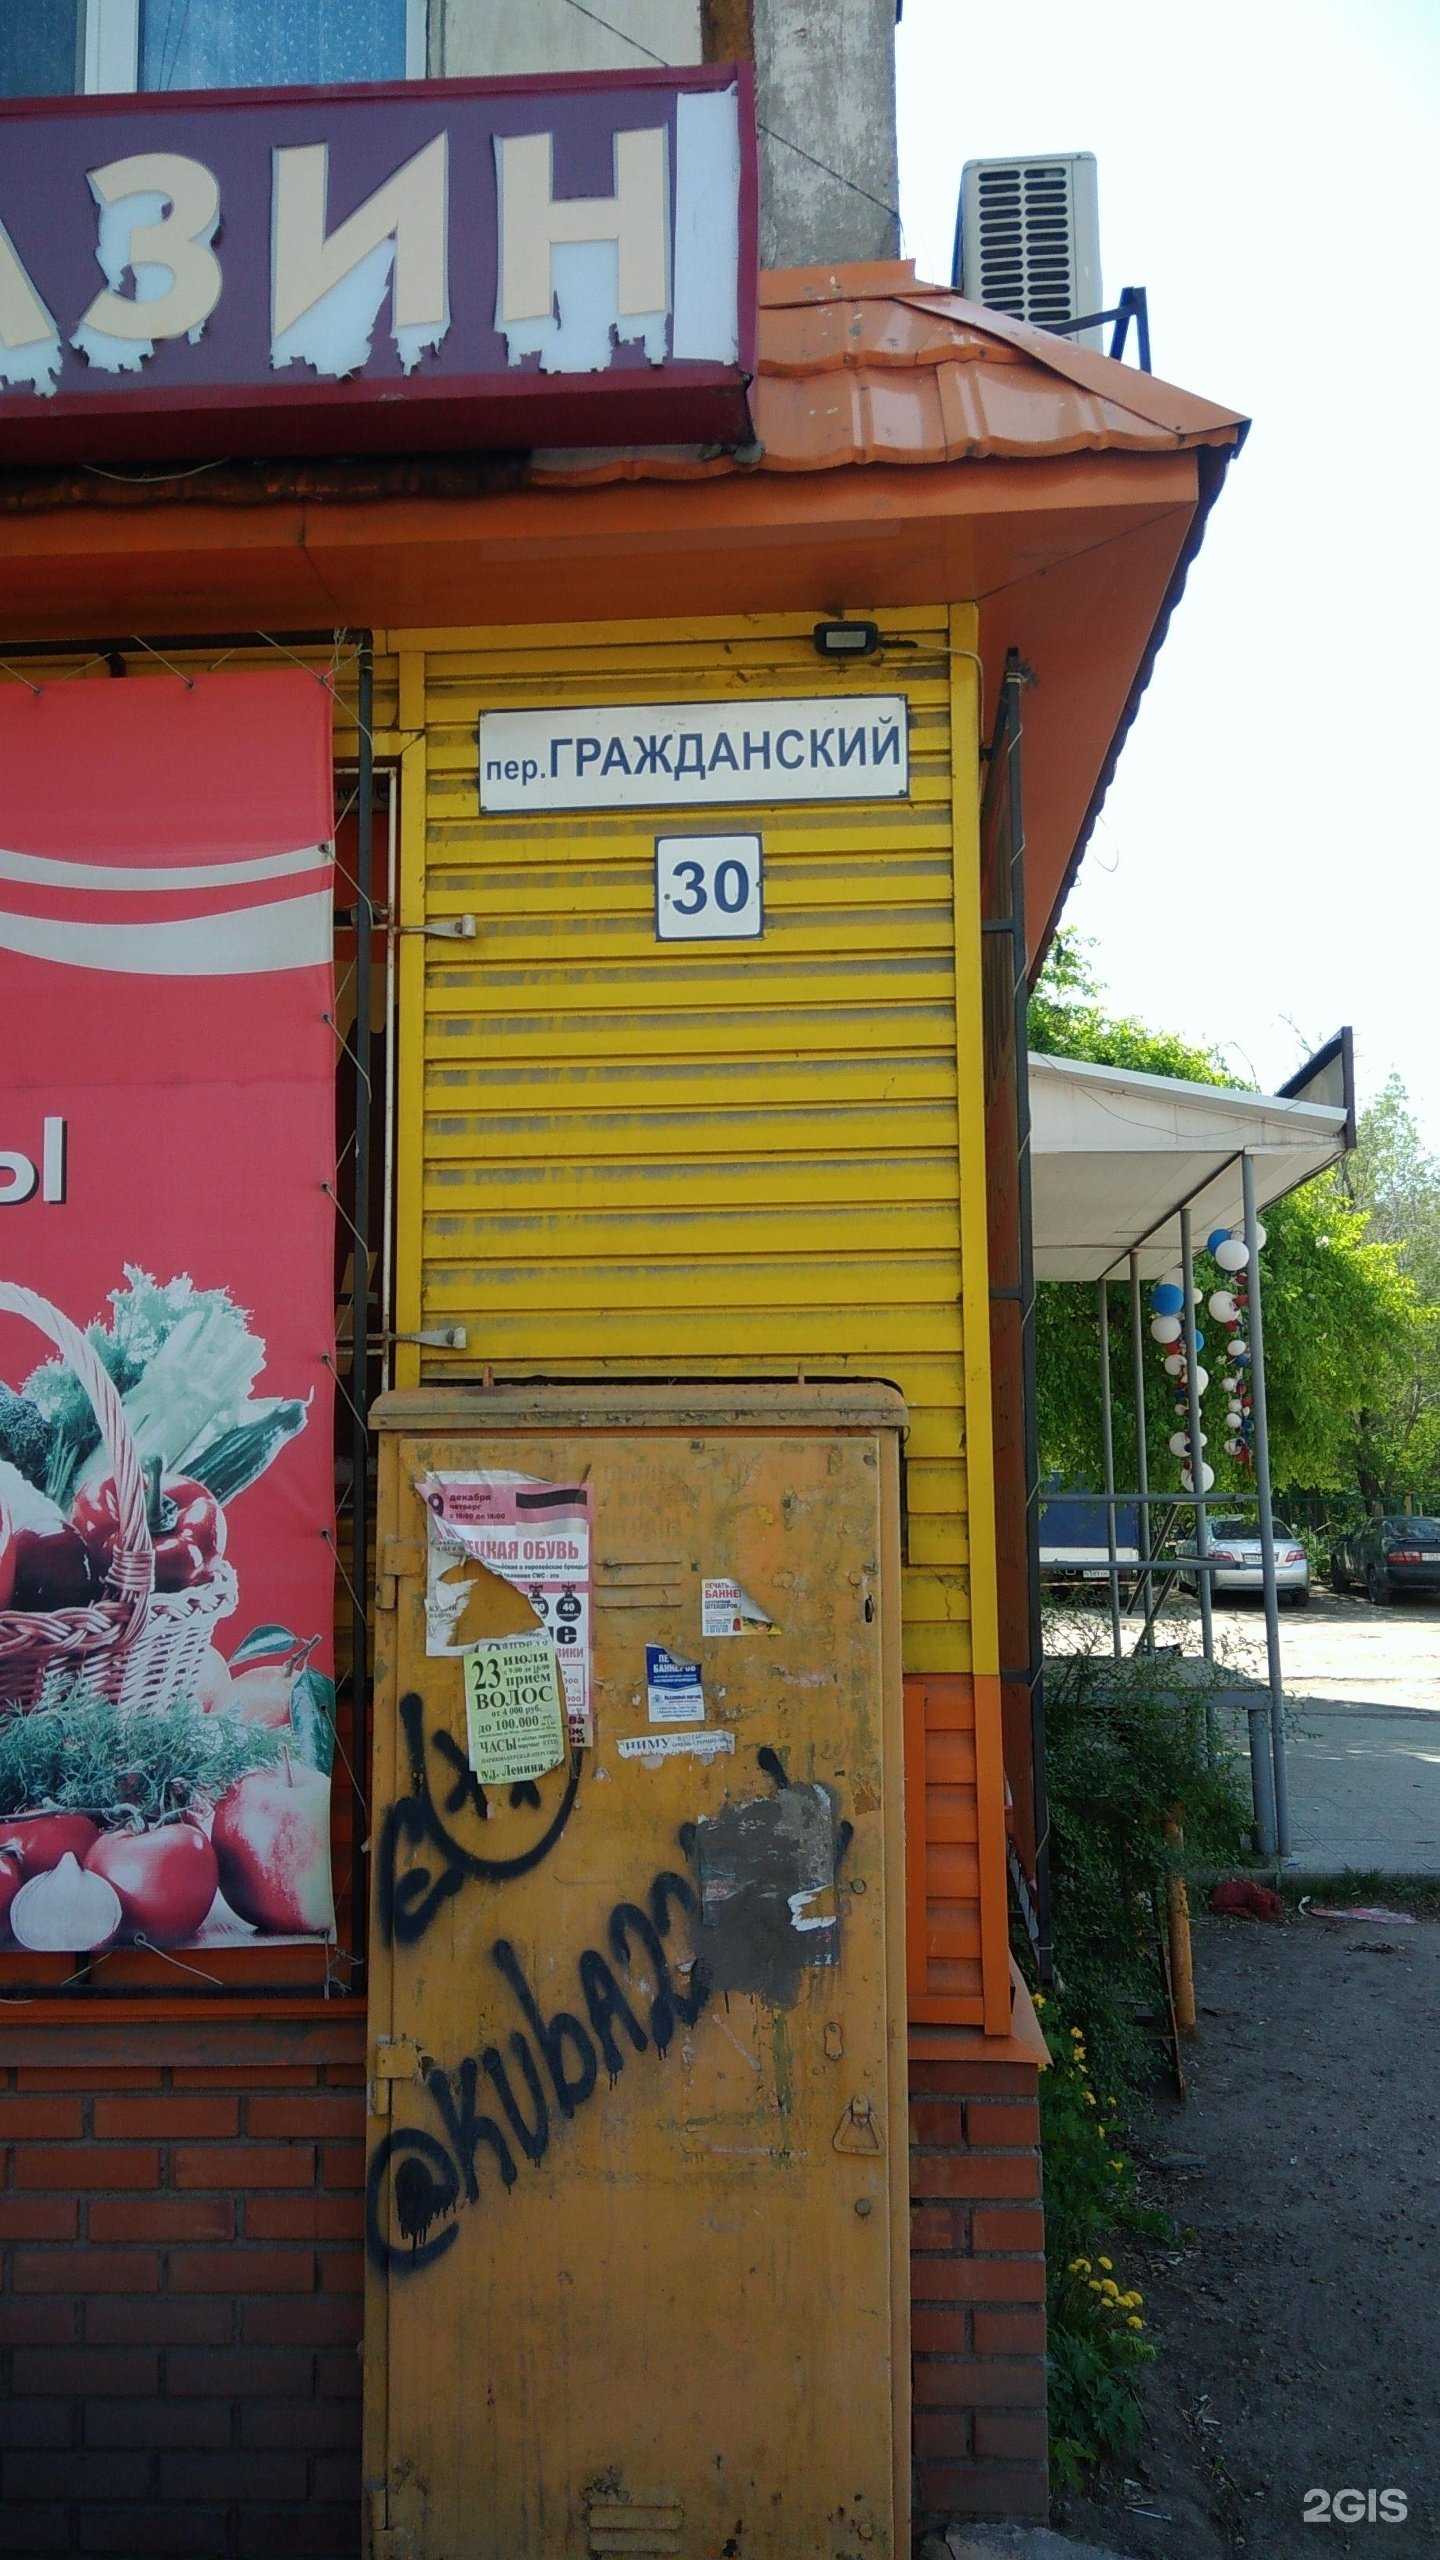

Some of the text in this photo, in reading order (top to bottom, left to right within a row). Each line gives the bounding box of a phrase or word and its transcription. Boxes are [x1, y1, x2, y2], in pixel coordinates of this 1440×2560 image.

[671, 859, 750, 915] 30
[450, 1493, 492, 1503] декабря
[523, 1540, 580, 1560] ОБУВЬ
[704, 1589, 741, 1599] БАННЕ
[562, 1602, 575, 1612] 40
[471, 1652, 549, 1690] 23 июля
[475, 1686, 553, 1710] ВОЛОС
[478, 1724, 492, 1735] до
[496, 1715, 539, 1731] 100.000
[480, 1737, 517, 1754] ЧАСЫ
